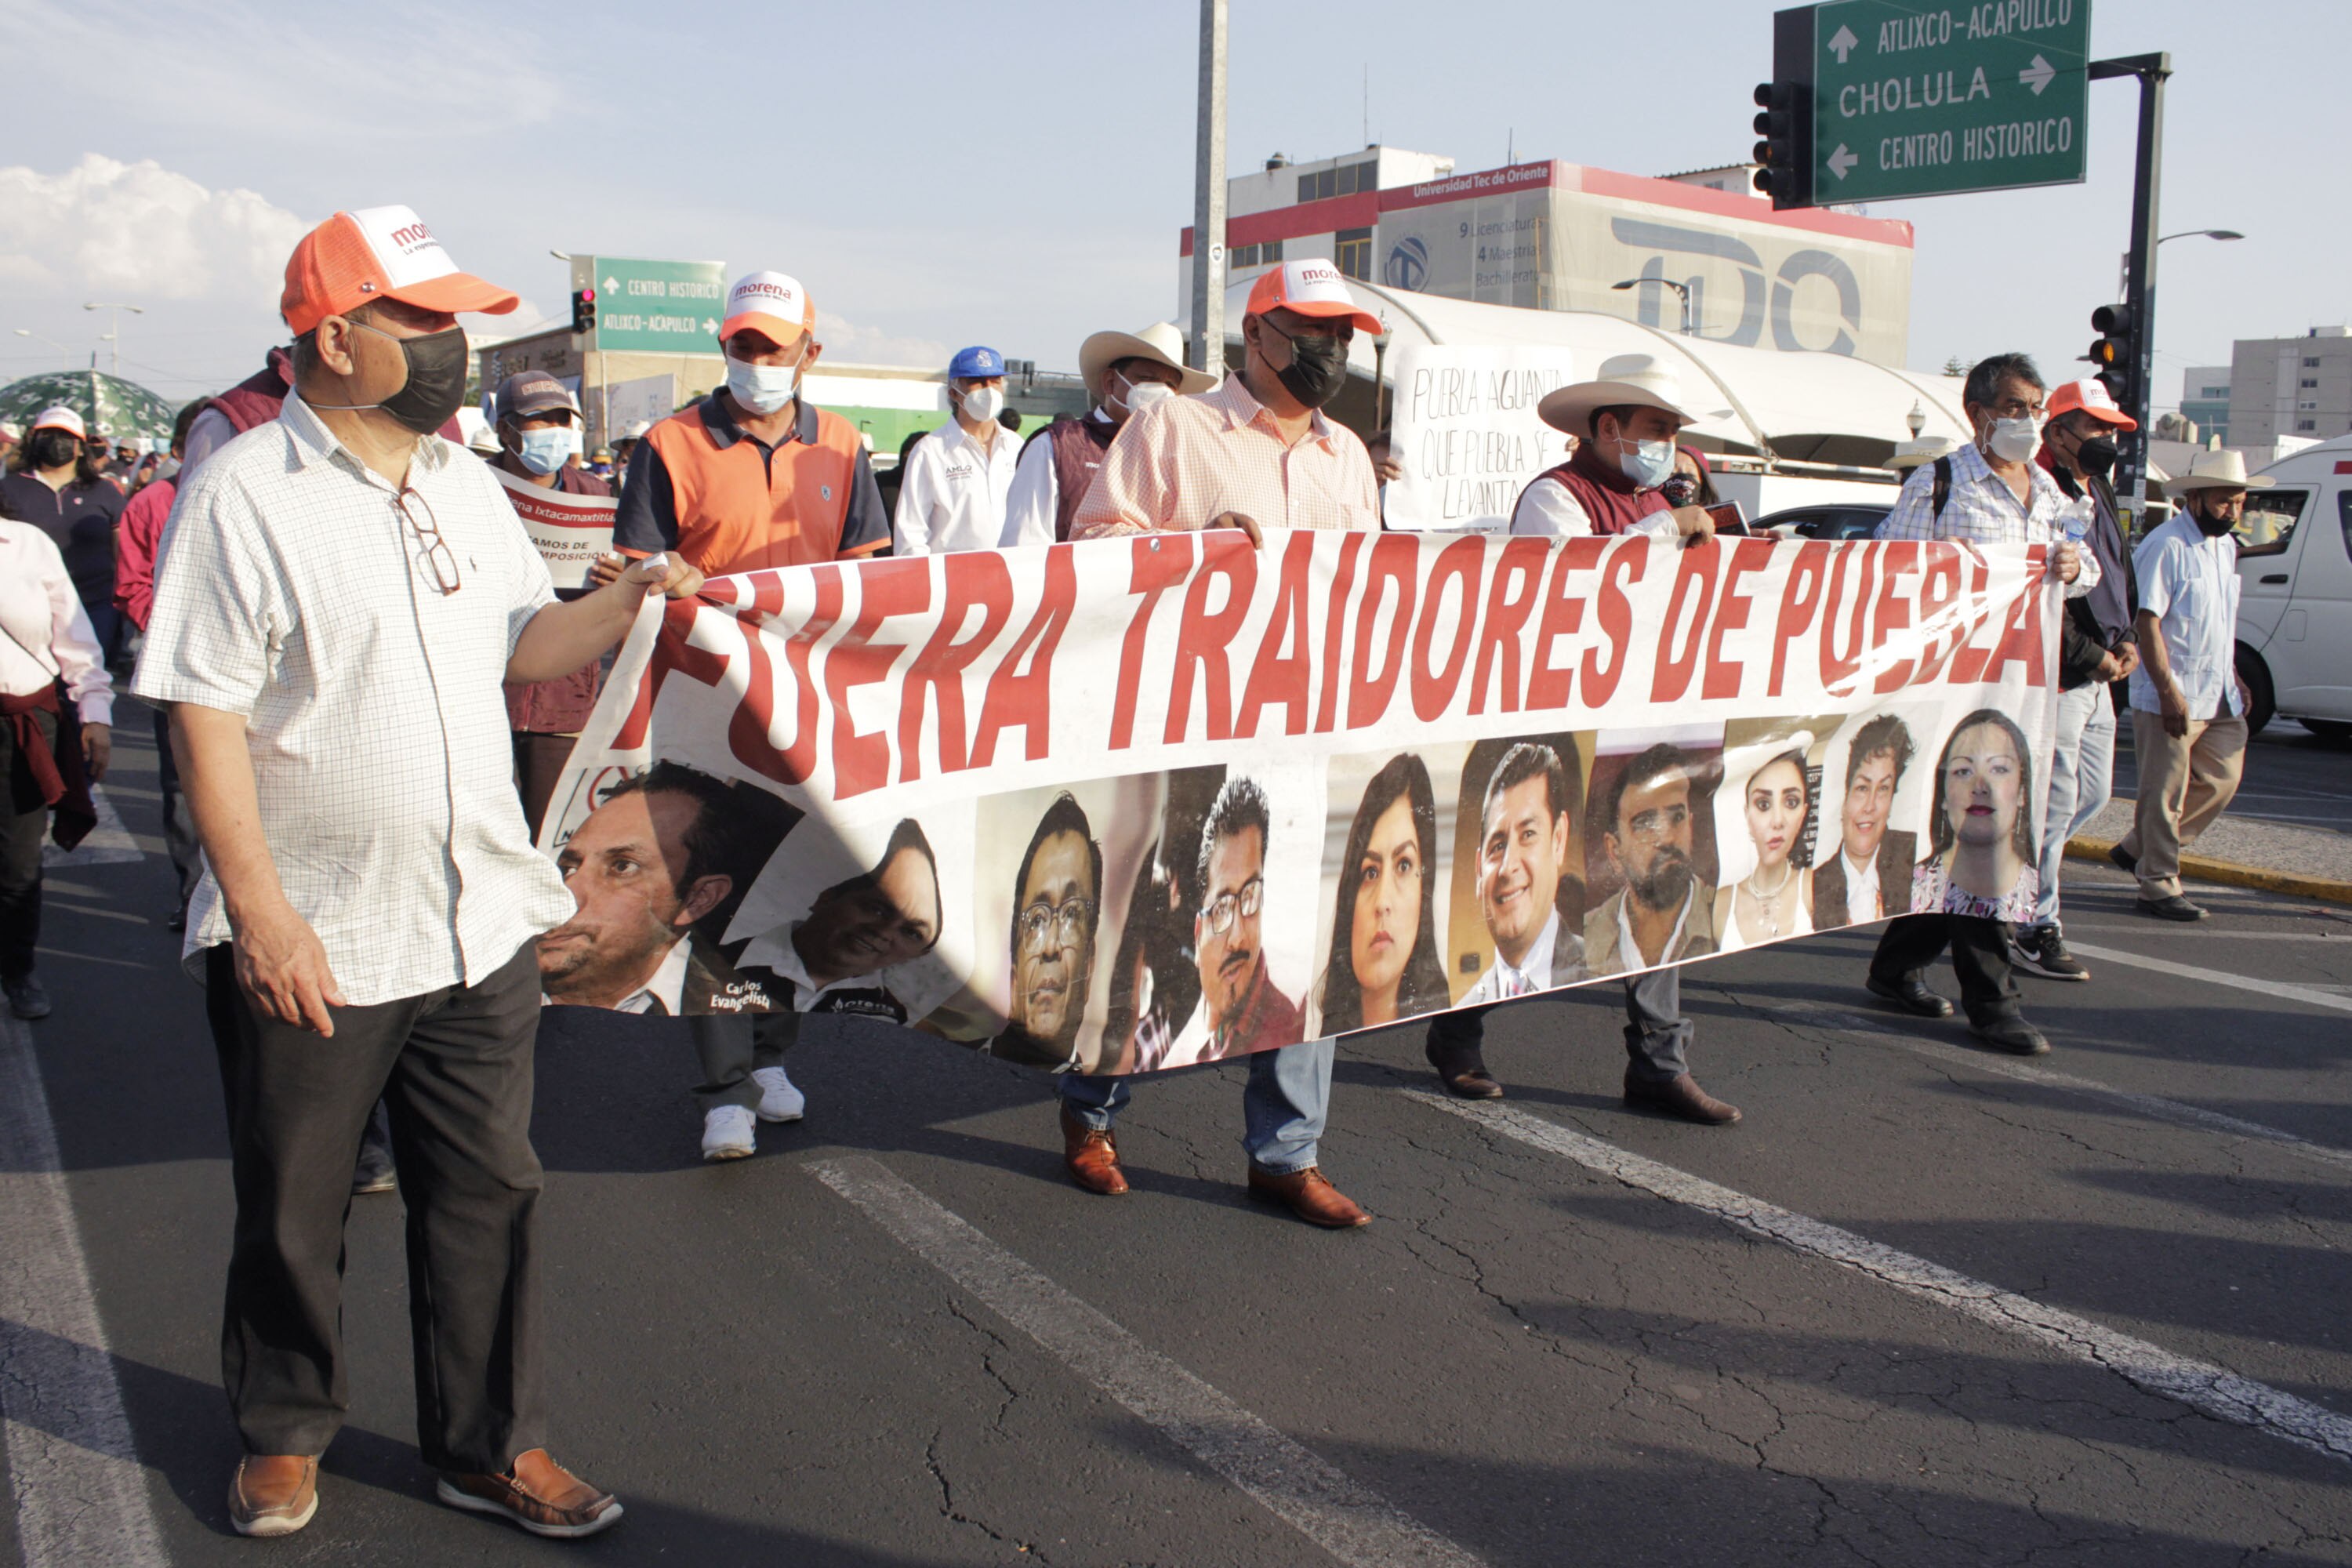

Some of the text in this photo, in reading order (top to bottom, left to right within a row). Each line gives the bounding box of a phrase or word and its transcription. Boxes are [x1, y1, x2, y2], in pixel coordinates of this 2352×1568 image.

[1839, 67, 1990, 117] CHOLULA
[1880, 117, 2071, 171] CENTRO HISTORICO
[1414, 165, 1548, 198] Universidad Tec de Oriente
[1460, 216, 1544, 238] 9 Licenciaturas
[1478, 245, 1487, 263] 4
[628, 279, 666, 297] CENTRO
[669, 281, 719, 299] HISTORICO
[735, 282, 791, 299] morena
[1413, 368, 1479, 423] PUEBLA
[1422, 428, 1551, 482] QUE PUEBLA SE
[946, 464, 972, 474] AMLO
[608, 530, 2048, 801] FUERA TRAIDORES DE PUEBLA
[726, 980, 762, 995] Carlos
[710, 991, 771, 1012] Evangelista
